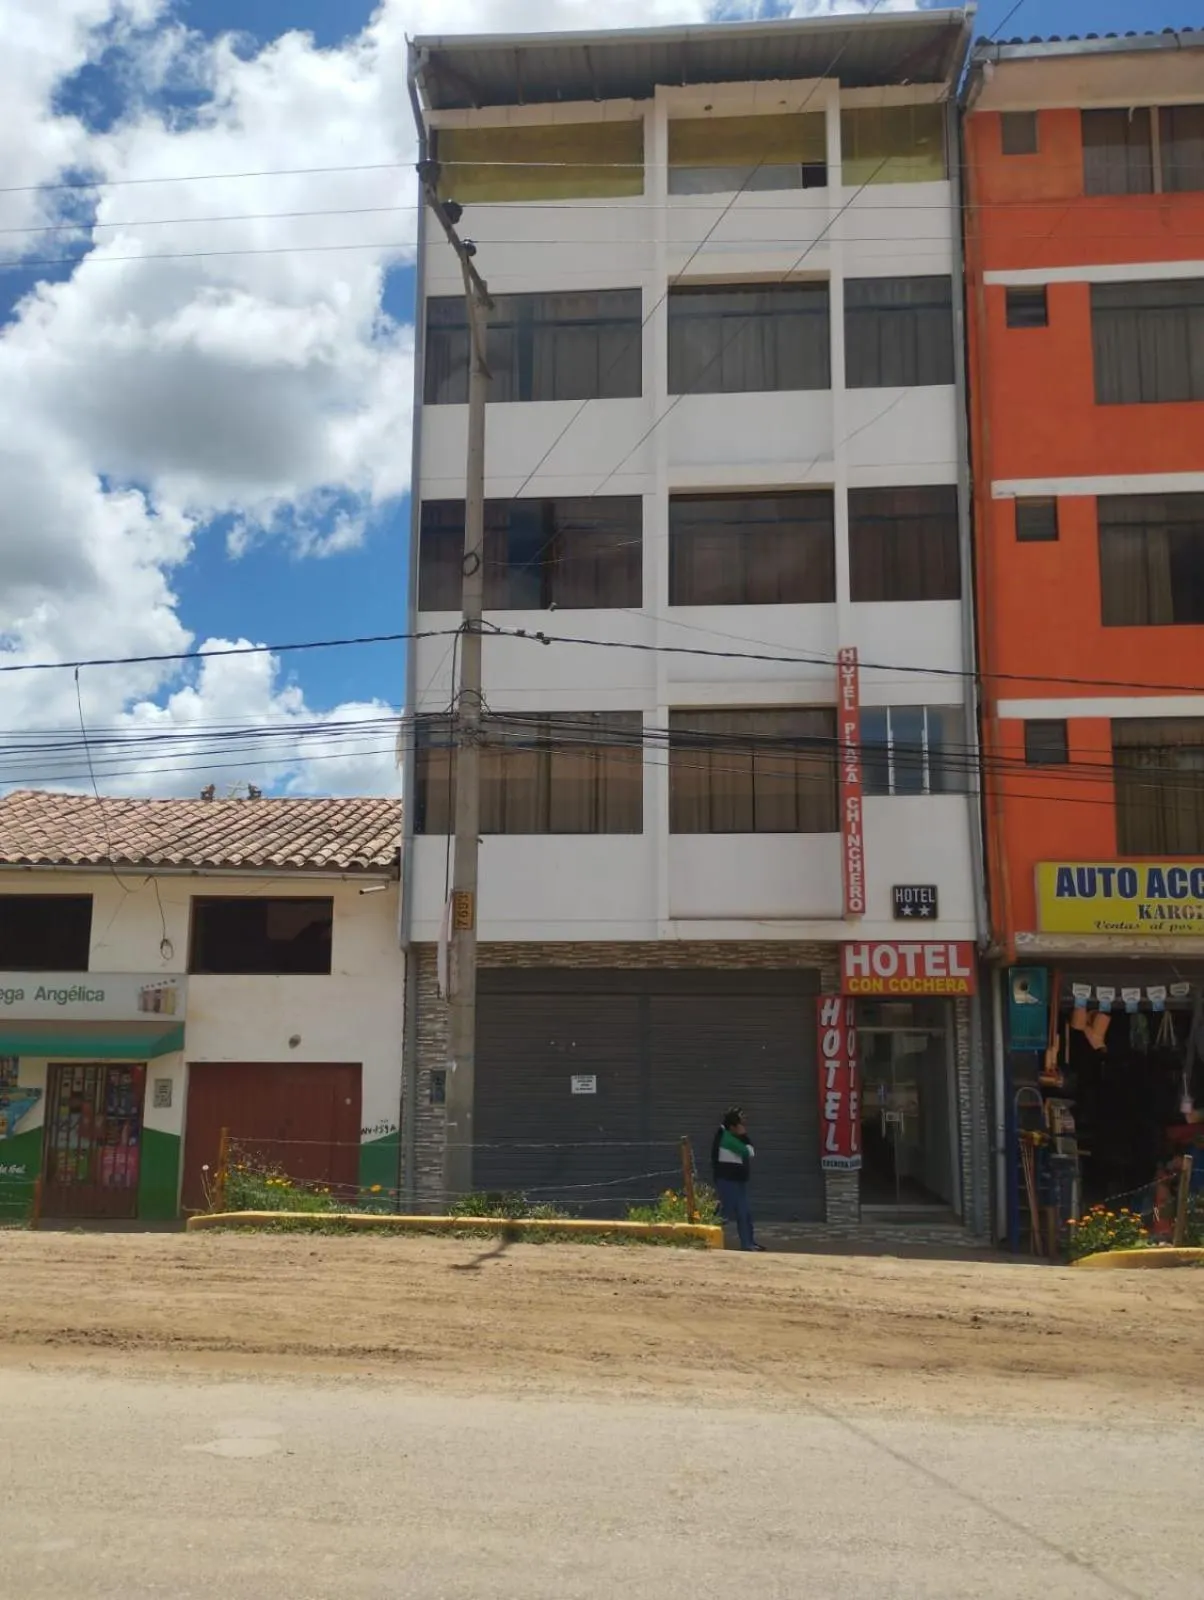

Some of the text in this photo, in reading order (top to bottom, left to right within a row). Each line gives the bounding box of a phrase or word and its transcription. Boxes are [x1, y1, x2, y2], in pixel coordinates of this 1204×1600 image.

[841, 649, 855, 711] HOTEL
[846, 797, 863, 911] CHINCHERO
[895, 888, 935, 903] HOTEL
[1056, 867, 1204, 899] AUTO ACC
[1094, 921, 1192, 932] Ventas al por
[845, 944, 970, 977] HOTEL
[34, 984, 105, 1005] Angélica
[849, 978, 968, 992] CON COCHERA
[820, 998, 842, 1152] HOTEL
[846, 999, 858, 1152] HOTEL
